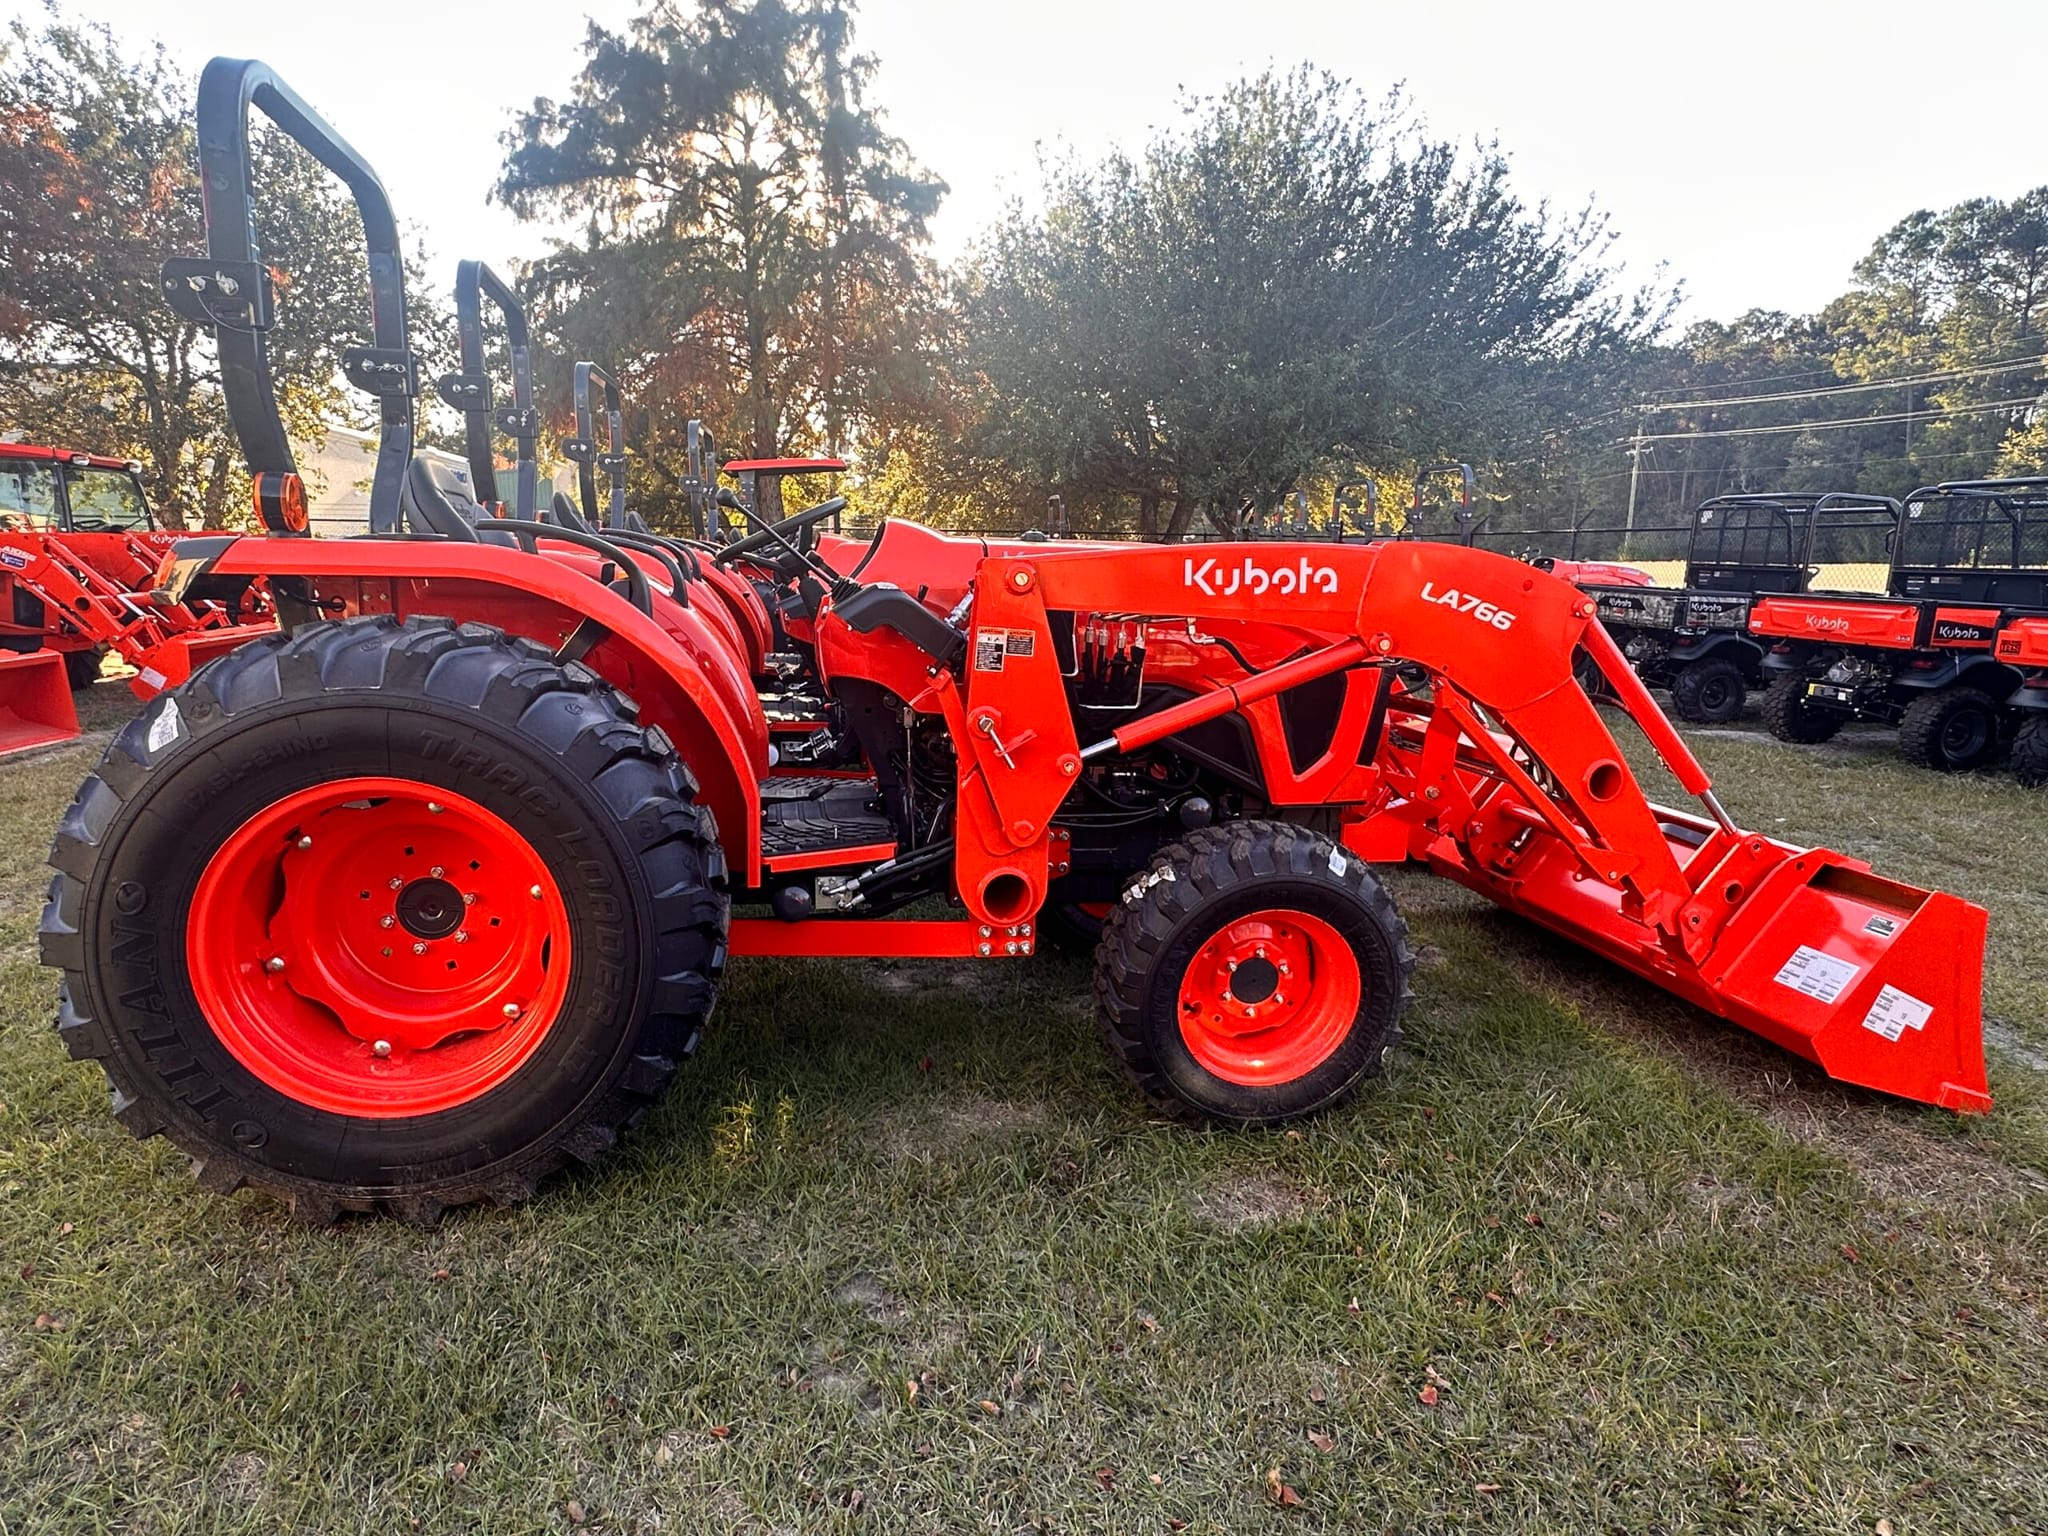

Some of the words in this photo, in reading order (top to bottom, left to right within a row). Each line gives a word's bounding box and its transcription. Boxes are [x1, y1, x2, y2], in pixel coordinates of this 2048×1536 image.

[1184, 557, 1339, 596] Kubota
[1419, 581, 1516, 631] LA766
[1609, 598, 1632, 608] Kubota
[1691, 602, 1722, 613] Kubota
[1806, 614, 1849, 631] Kubota
[1939, 626, 1979, 639] Kubota
[420, 729, 560, 818] TRAC
[554, 826, 627, 1028] LOADER
[110, 919, 241, 1125] TITAN
